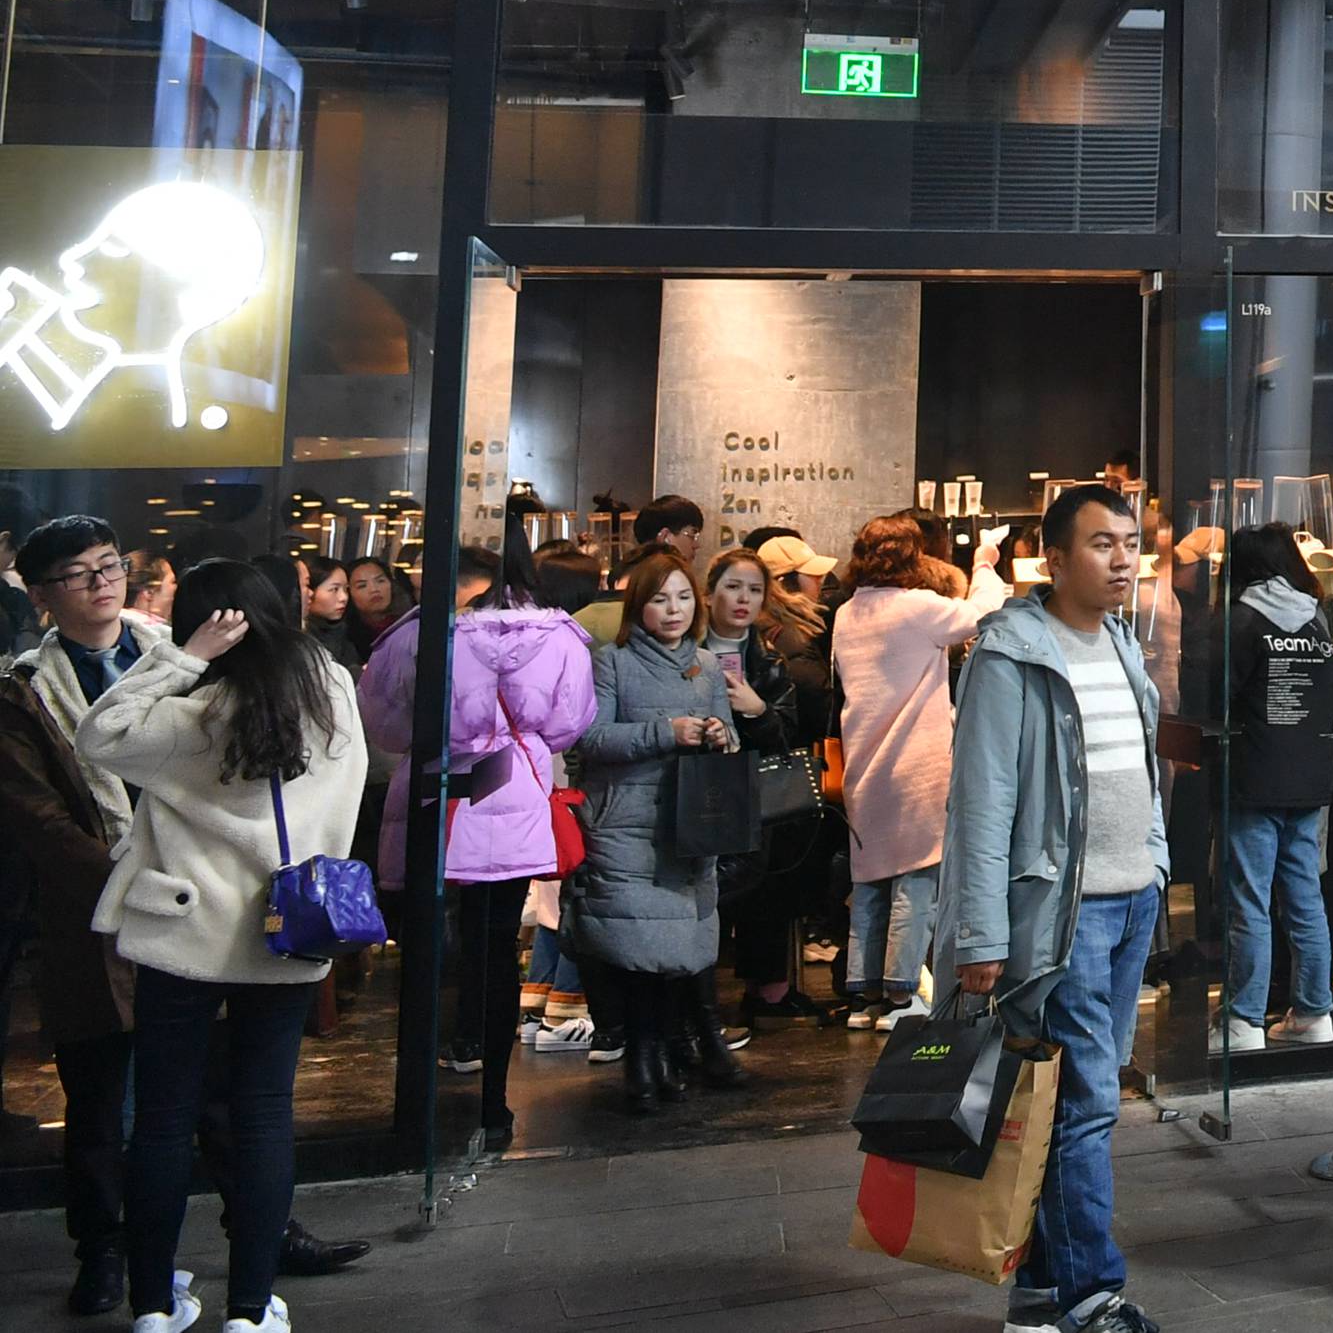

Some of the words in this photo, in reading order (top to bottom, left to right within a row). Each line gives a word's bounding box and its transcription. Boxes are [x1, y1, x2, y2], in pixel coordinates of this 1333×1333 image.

[1242, 303, 1272, 316] L119a
[724, 431, 779, 451] Cool
[721, 462, 855, 486] inspiration
[721, 493, 761, 514] Zen
